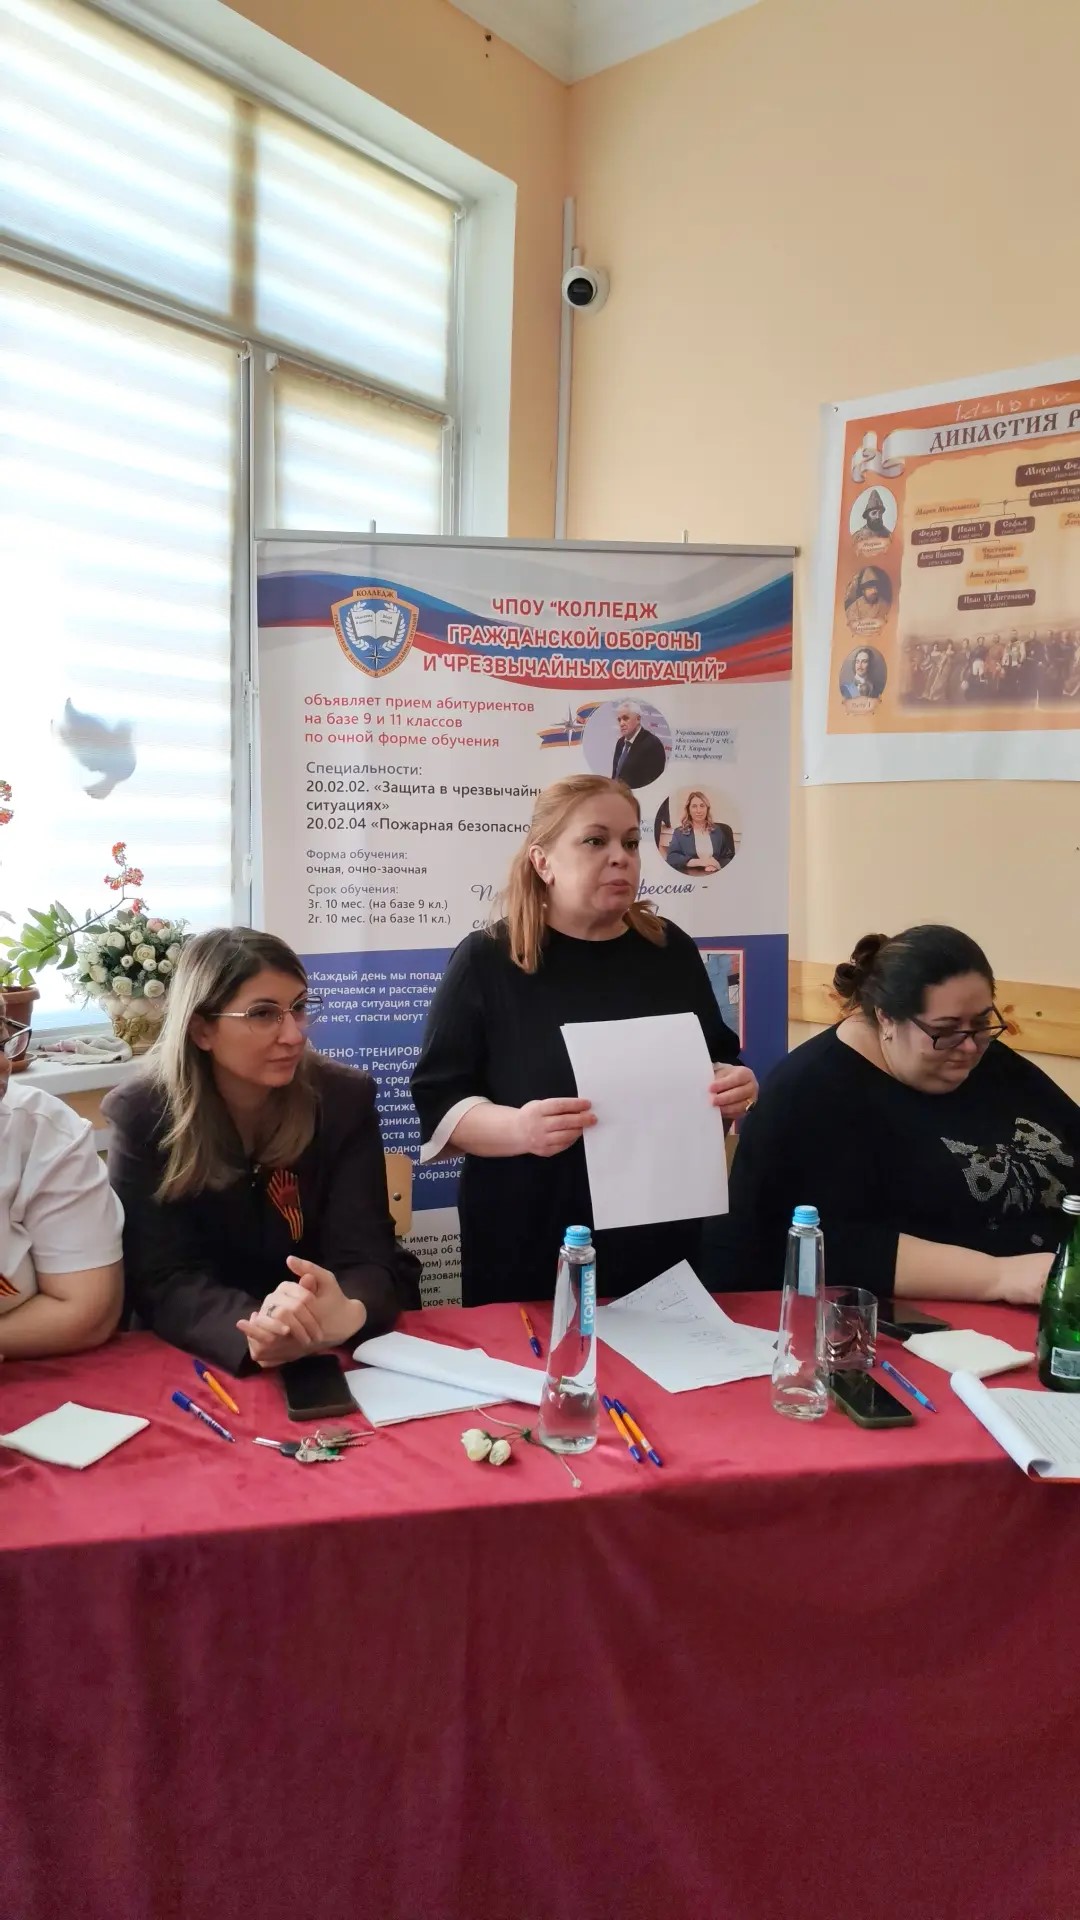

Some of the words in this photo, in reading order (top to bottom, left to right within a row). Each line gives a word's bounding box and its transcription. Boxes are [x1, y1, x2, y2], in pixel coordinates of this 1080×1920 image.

[930, 412, 1058, 453] ДИНАСТИЯ
[492, 598, 544, 616] ЧПОУ
[550, 600, 658, 620] “КОЛЛЕДЖ
[449, 626, 600, 648] ГРАЖДАНСКОЙ
[605, 631, 700, 650] ОБОРОНЫ
[423, 655, 437, 671] И
[444, 655, 608, 678] ЧРЕЗВЫЧАЙНЫХ
[612, 657, 727, 682] СИТУАЦИЙ”
[304, 694, 381, 706] объявляет
[386, 697, 432, 710] прием
[437, 697, 535, 713] абитуриентов
[304, 715, 321, 724] на
[327, 713, 359, 725] базе
[364, 713, 371, 724] 9
[377, 716, 385, 725] и
[390, 714, 401, 725] 11
[406, 716, 463, 728] классов
[304, 733, 322, 743] по
[328, 731, 373, 743] очной
[378, 732, 427, 747] форме
[431, 734, 499, 749] обучения
[306, 762, 422, 776] Специальности:
[306, 780, 370, 793] 20.02.02.
[374, 781, 435, 796] «Защита
[440, 785, 447, 794] в
[306, 801, 389, 814] ситуациях»
[306, 818, 366, 830] 20.02.04
[371, 818, 453, 833] «Пожарная
[458, 820, 530, 833] безопасно
[306, 849, 346, 862] Форма
[349, 849, 408, 862] обучения:
[306, 866, 344, 875] очная,
[347, 865, 427, 874] очно-заочная
[308, 884, 337, 896] Срок
[340, 884, 399, 897] обучения:
[308, 899, 322, 909] 3г.
[326, 899, 337, 909] 10
[341, 901, 365, 909] мес.
[369, 899, 385, 910] (на
[389, 899, 414, 909] базе
[418, 899, 425, 909] 9
[428, 900, 448, 910] кл.)
[308, 914, 323, 924] 2г.
[326, 914, 338, 924] 10
[341, 916, 365, 924] мес.
[369, 914, 386, 925] (на
[389, 914, 415, 924] базе
[419, 914, 428, 923] 11
[431, 914, 451, 925] кл.)
[307, 971, 358, 983] «Каждый
[361, 973, 386, 982] день
[410, 972, 445, 982] попад
[307, 986, 375, 997] встречаемся
[389, 985, 437, 996] расстаём
[328, 1001, 358, 1010] когда
[361, 1000, 410, 1010] ситуация
[413, 1000, 432, 1008] ста
[331, 1015, 352, 1024] нет,
[355, 1014, 390, 1022] спасти
[393, 1014, 424, 1024] могут
[362, 1063, 369, 1071] в
[386, 1076, 410, 1086] сред
[384, 1090, 390, 1098] и
[410, 1235, 438, 1243] иметь
[441, 1245, 453, 1254] об
